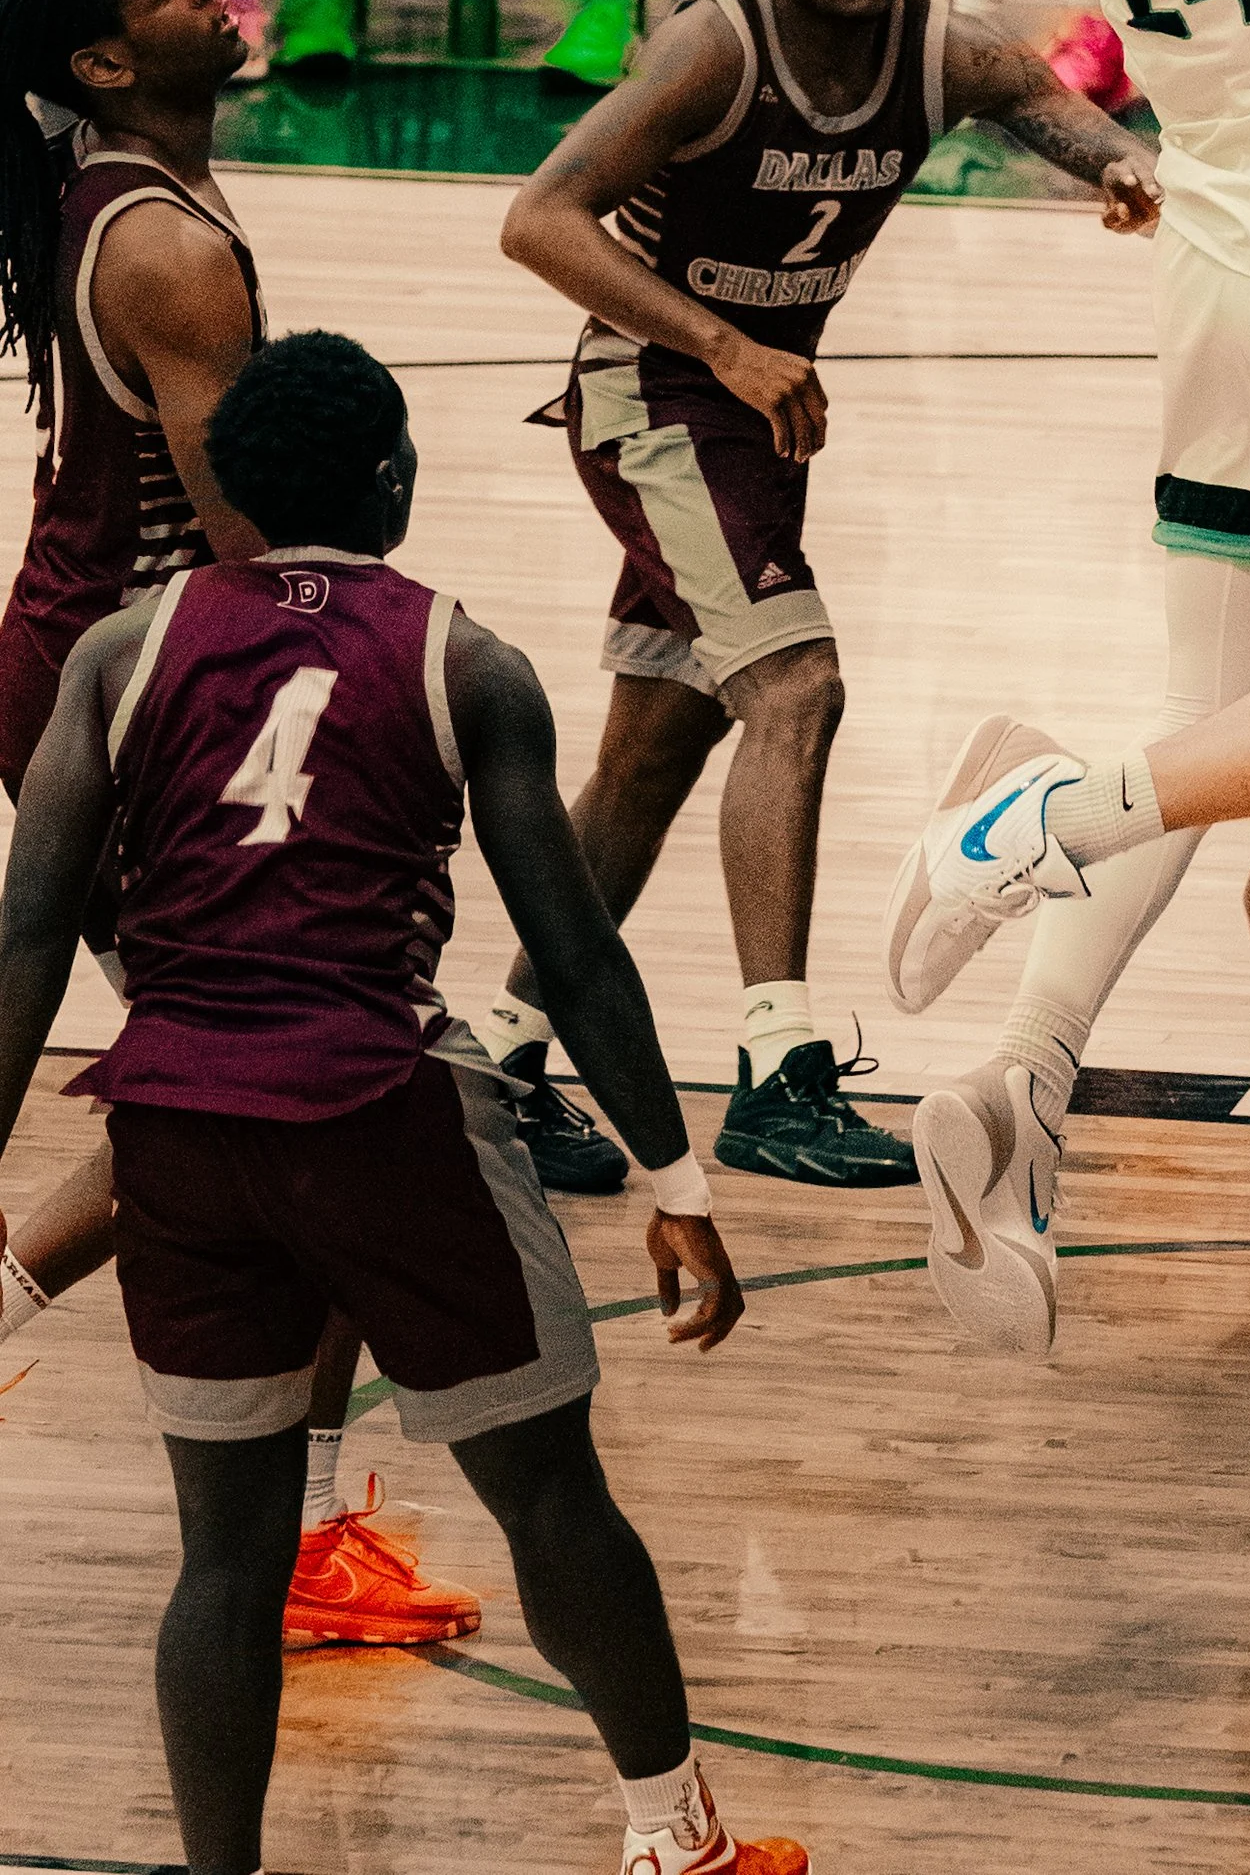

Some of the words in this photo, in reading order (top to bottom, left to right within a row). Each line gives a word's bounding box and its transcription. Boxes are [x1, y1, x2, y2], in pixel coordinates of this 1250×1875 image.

[752, 148, 903, 192] DALLAS
[780, 199, 842, 265] 2
[216, 665, 339, 845] 4
